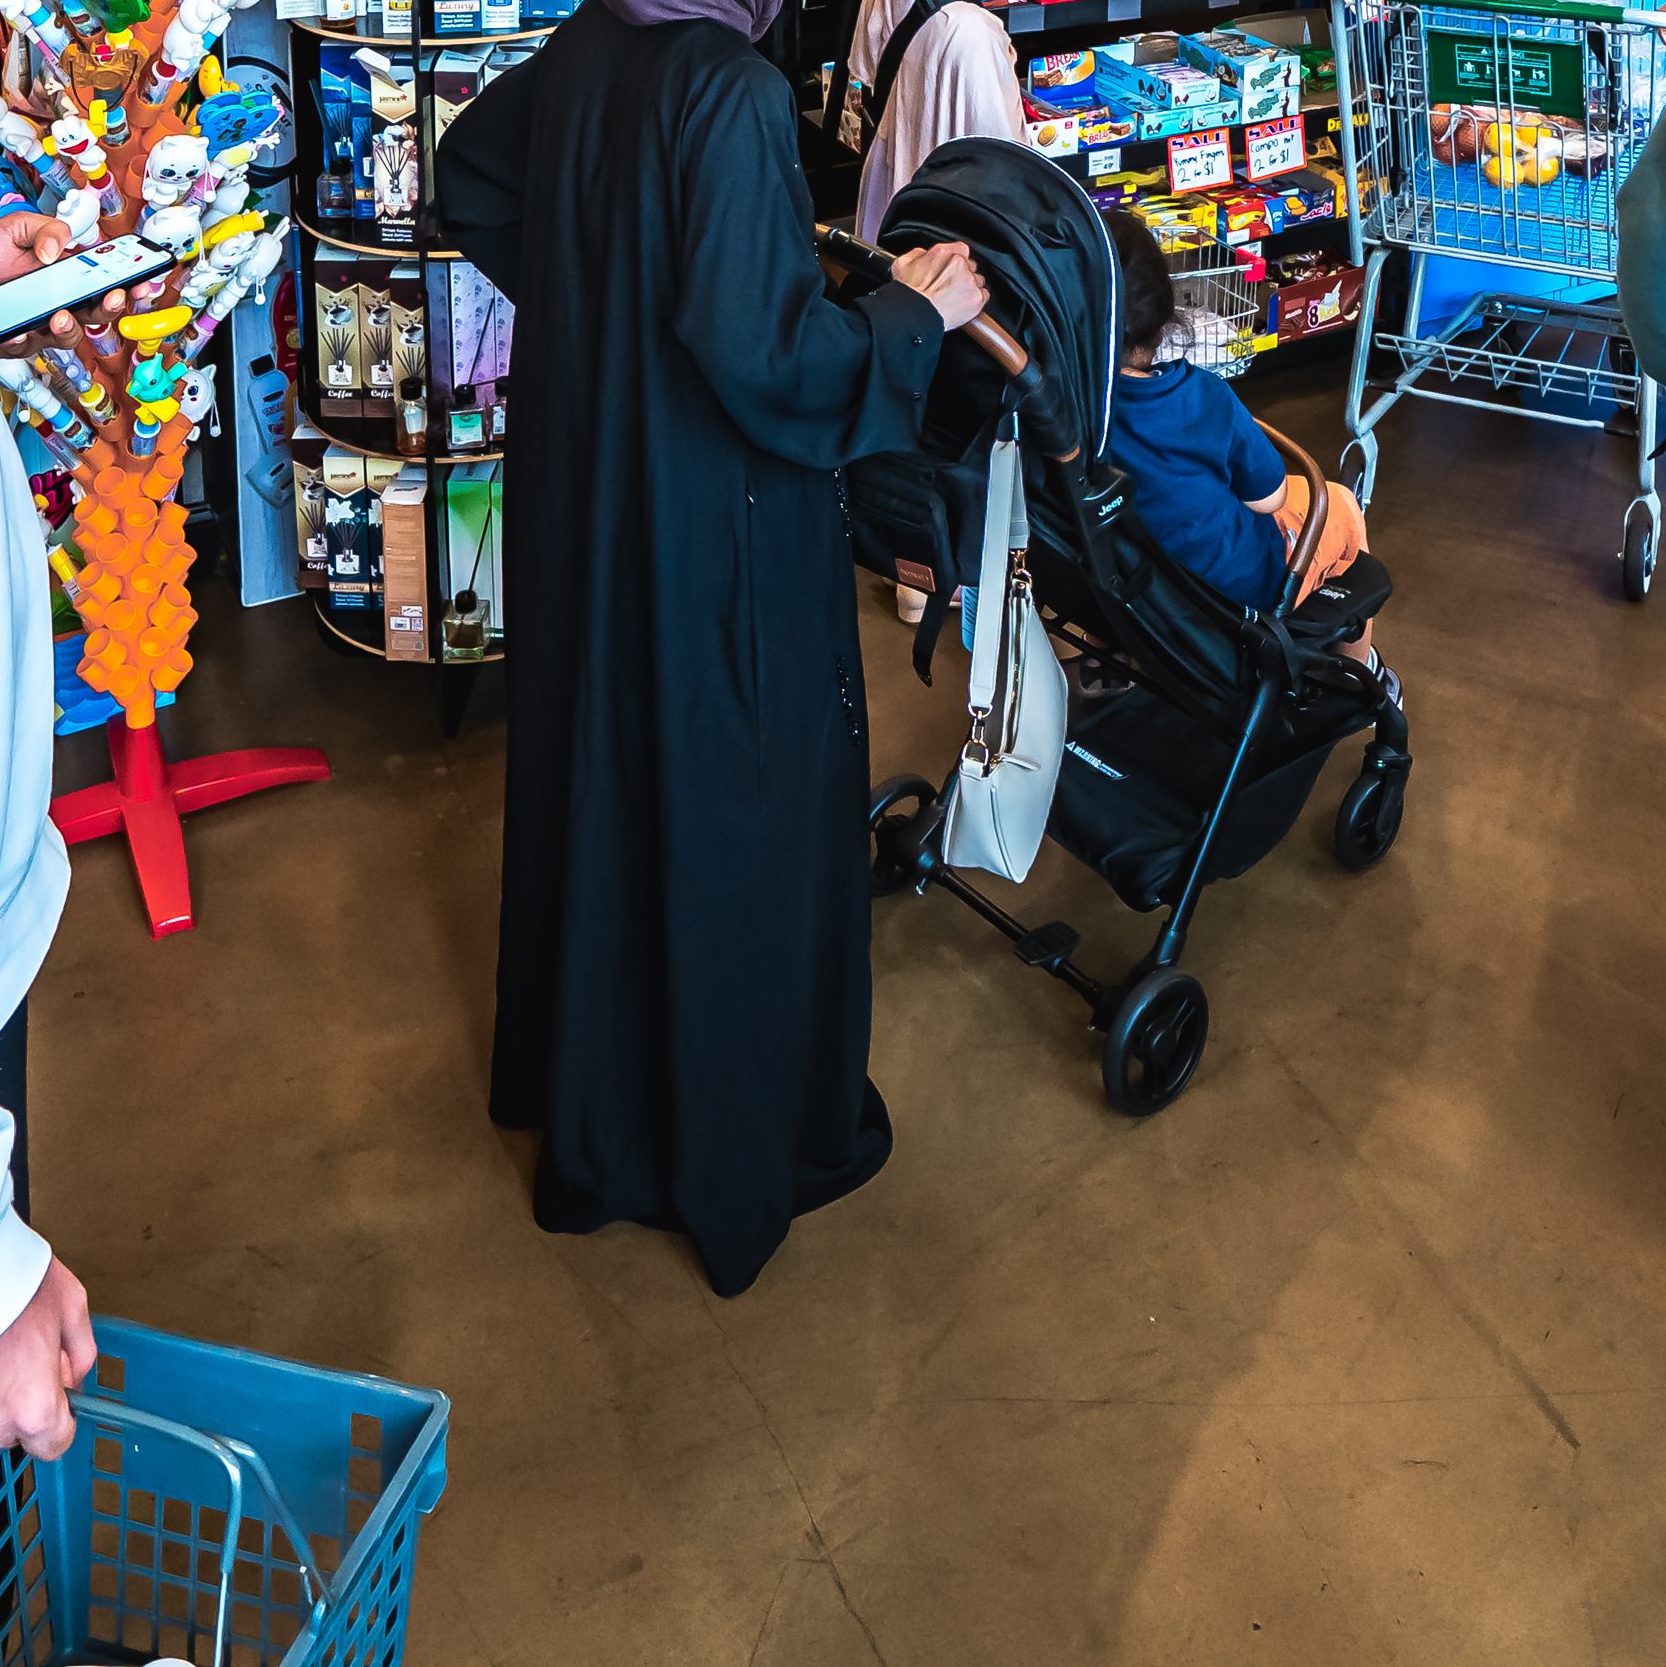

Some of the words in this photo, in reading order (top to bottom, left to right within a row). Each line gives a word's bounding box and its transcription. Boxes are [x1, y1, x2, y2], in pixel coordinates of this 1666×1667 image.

[1248, 118, 1299, 140] SALE
[1171, 132, 1223, 150] SALE
[1173, 154, 1200, 169] Yummy
[1200, 149, 1225, 165] Fingers
[1254, 159, 1266, 172] 2
[1177, 168, 1191, 184] 2
[327, 388, 353, 399] Coffee
